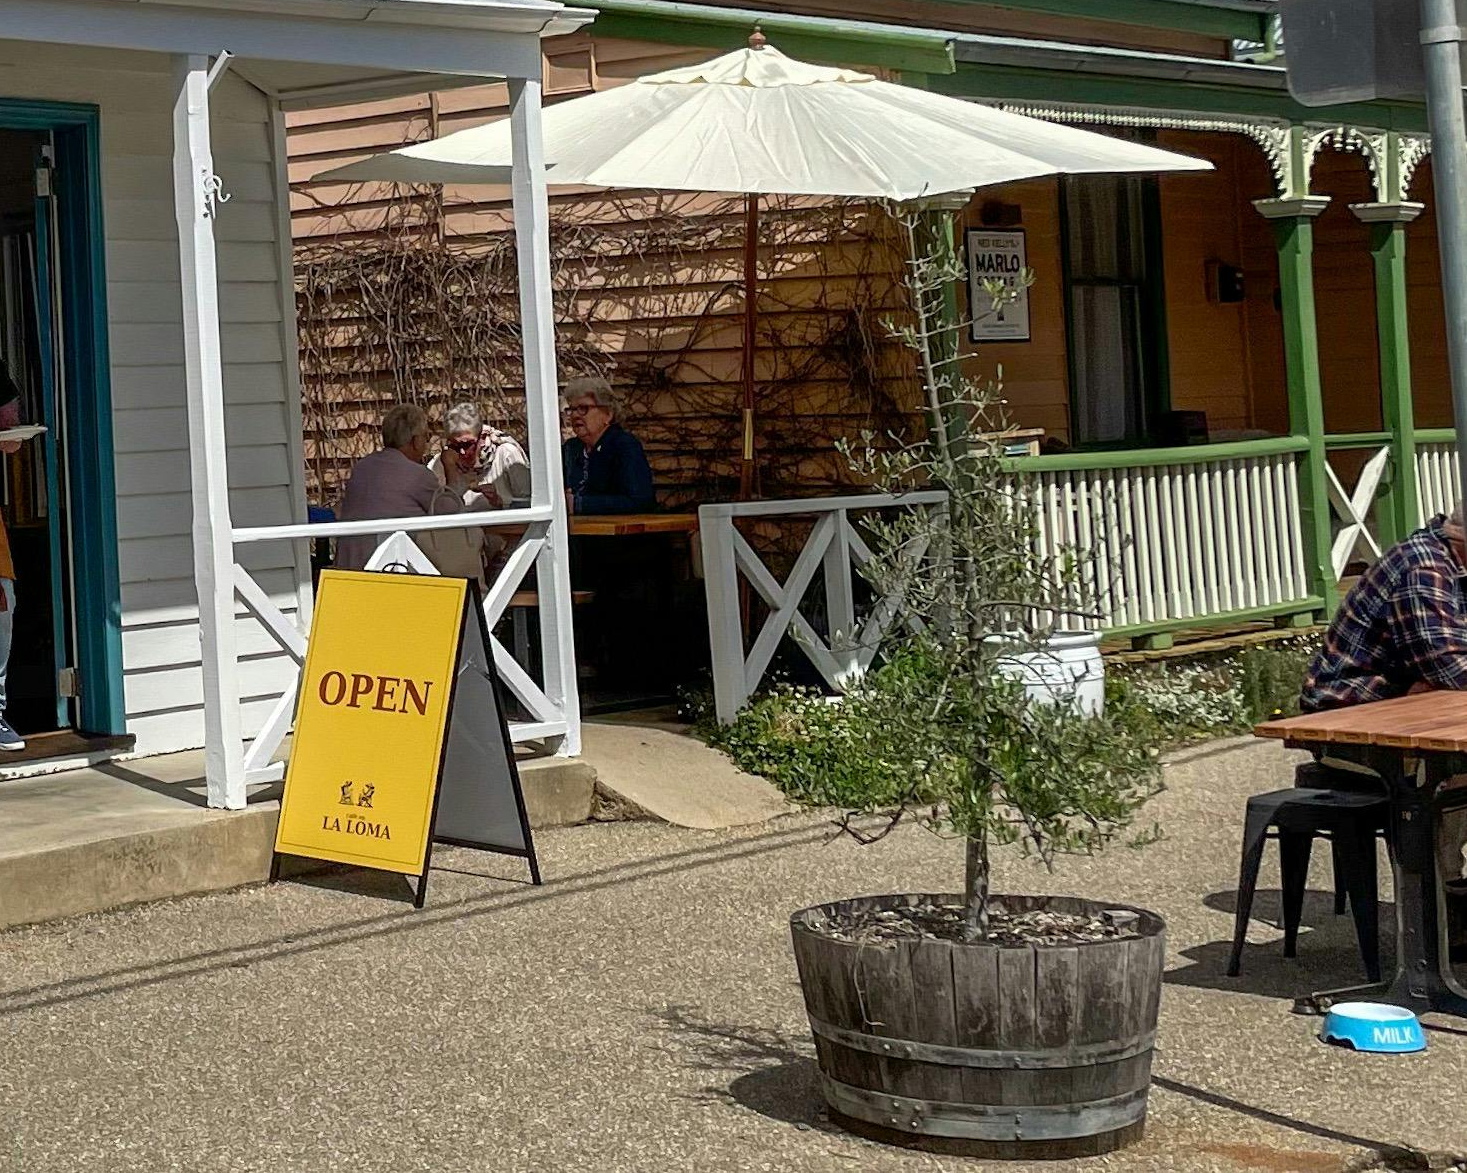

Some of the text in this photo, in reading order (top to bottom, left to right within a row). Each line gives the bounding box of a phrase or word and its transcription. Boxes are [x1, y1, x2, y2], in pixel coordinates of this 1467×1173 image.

[975, 253, 1020, 273] MARLO
[318, 670, 434, 716] OPEN
[322, 815, 391, 840] LA LOMA
[1373, 1026, 1414, 1044] MILK
